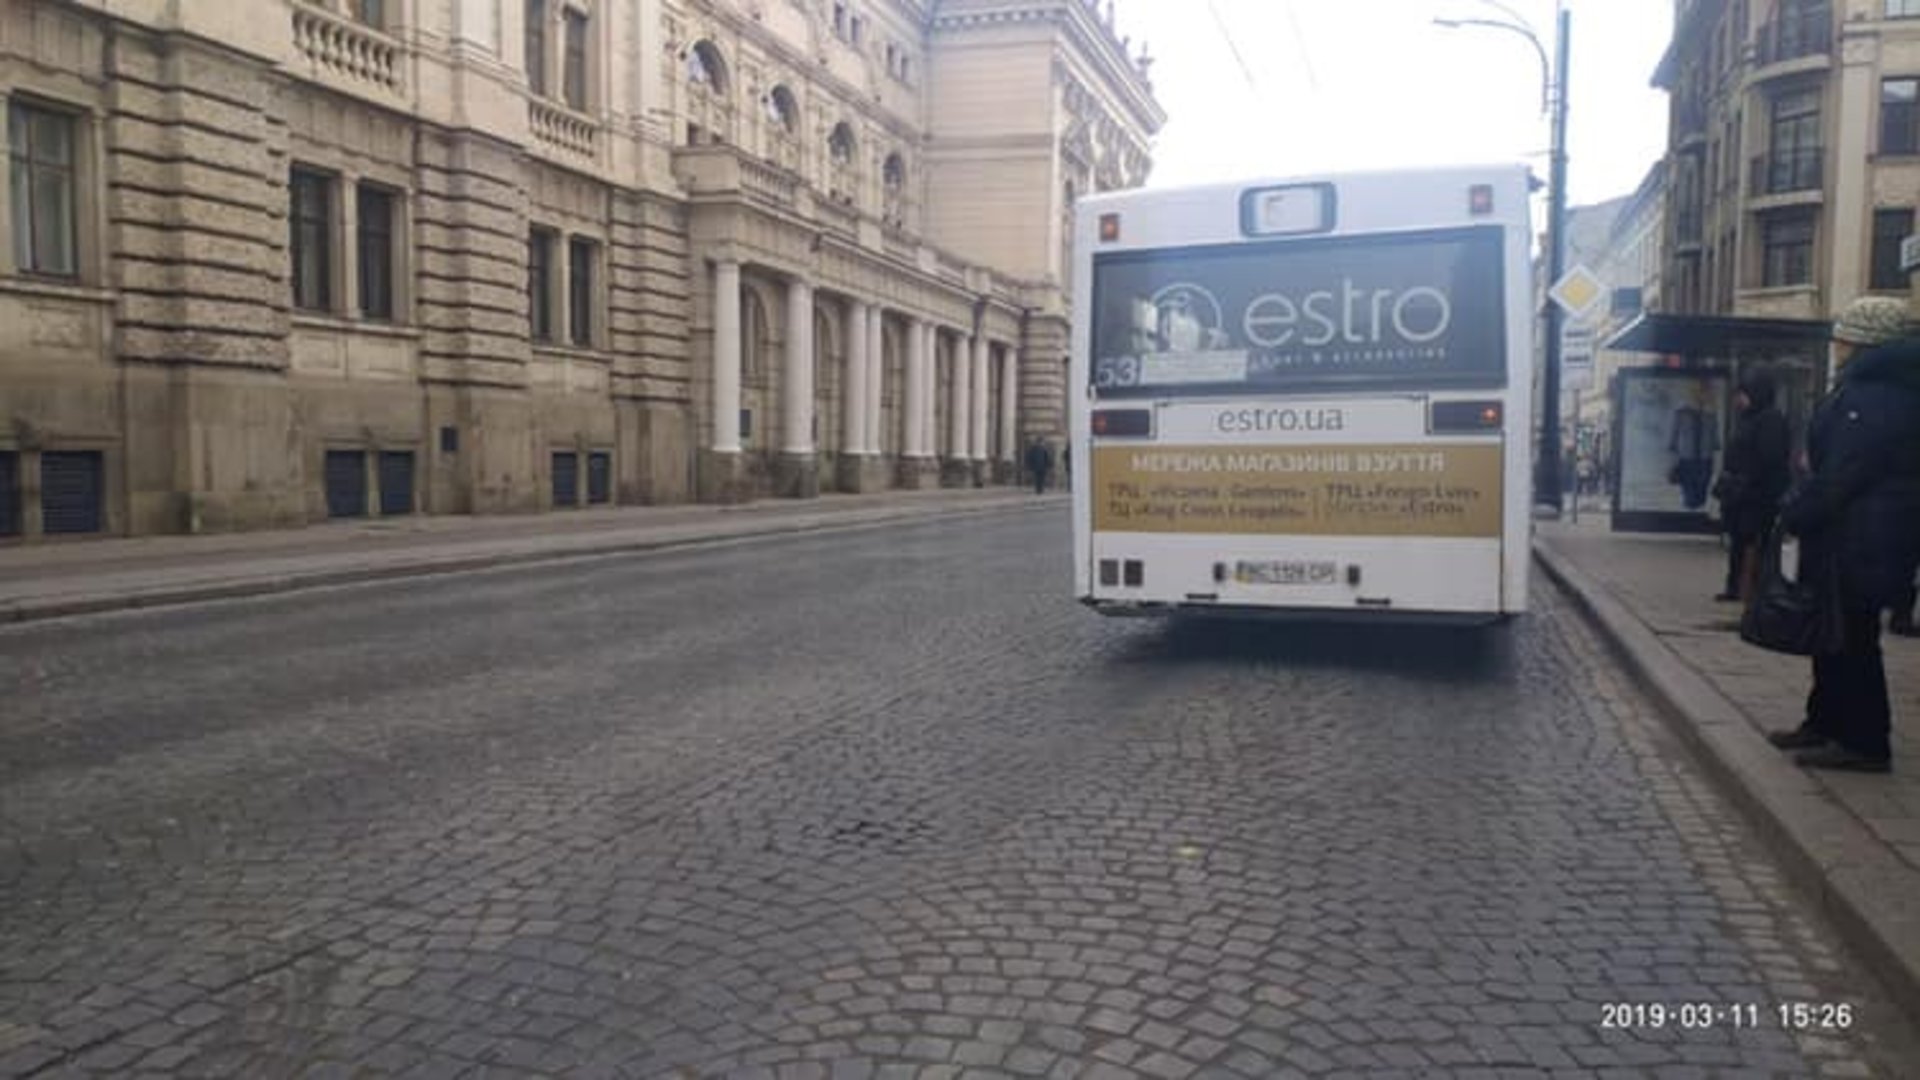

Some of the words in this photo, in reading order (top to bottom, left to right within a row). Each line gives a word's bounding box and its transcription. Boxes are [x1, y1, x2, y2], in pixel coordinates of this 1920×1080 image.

[1243, 278, 1451, 348] estro
[1097, 355, 1139, 387] 53
[1218, 407, 1344, 432] estro.ua
[1357, 452, 1446, 472] ВЗУТТЯ
